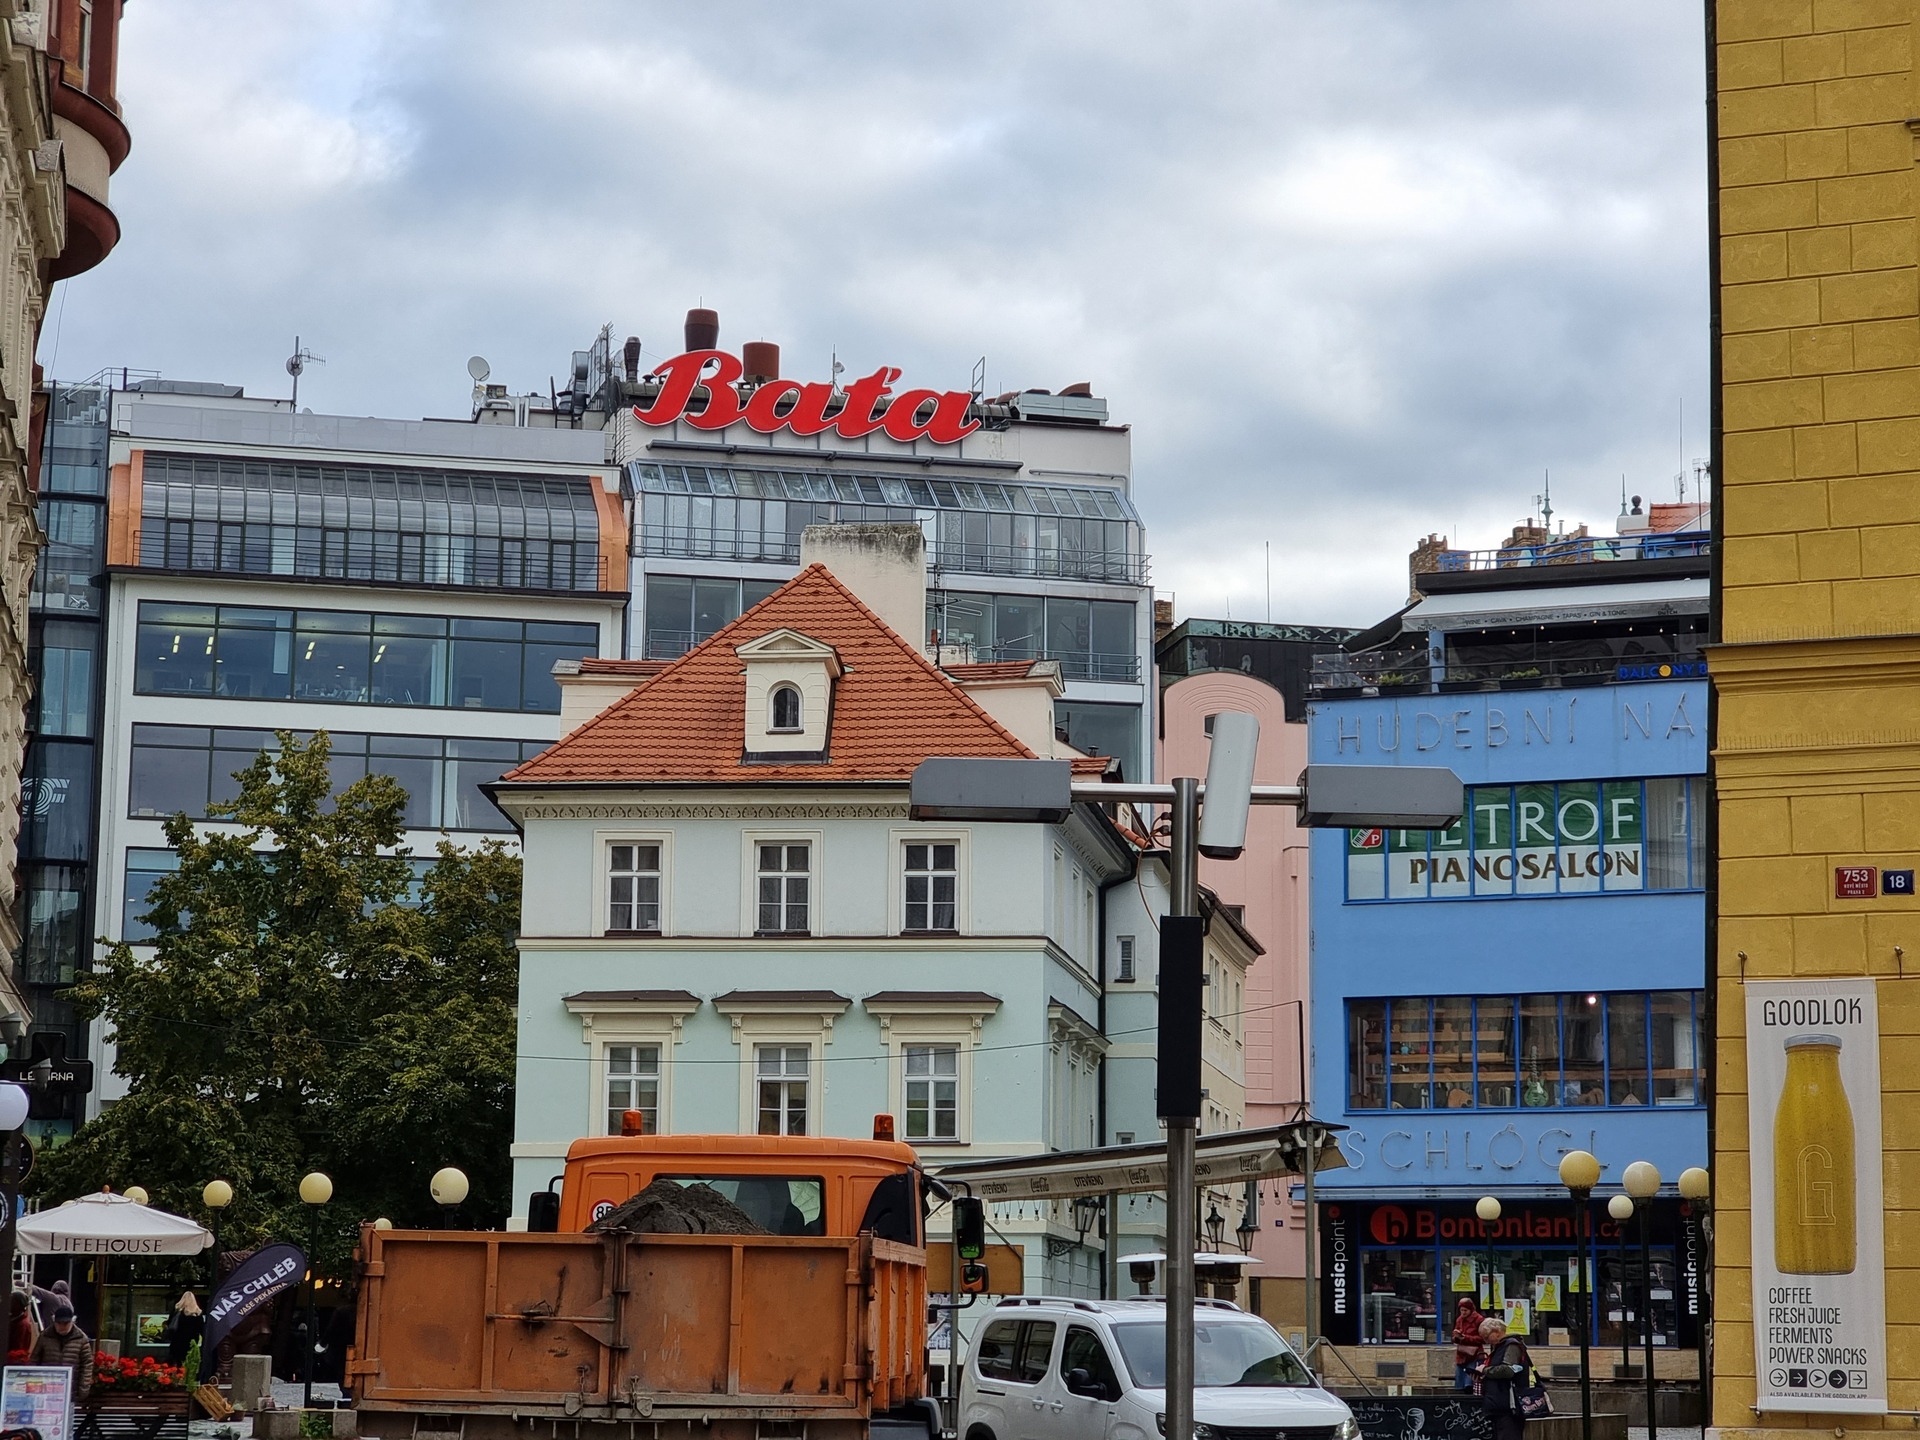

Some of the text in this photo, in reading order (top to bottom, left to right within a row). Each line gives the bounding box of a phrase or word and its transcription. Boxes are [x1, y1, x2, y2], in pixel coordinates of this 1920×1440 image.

[1338, 692, 1695, 755] HUDEBNÍ NÁ
[1398, 798, 1635, 848] ETROF
[1409, 849, 1640, 885] PIANOSALON
[1844, 870, 1868, 882] 753
[1889, 875, 1905, 889] 18
[1763, 998, 1862, 1026] GOODLOK
[19, 1071, 74, 1081] LÉRNA
[1797, 1144, 1837, 1226] G
[1330, 1220, 1349, 1314] musicpoint
[210, 1257, 297, 1321] NÁŠ CHLÉB
[1769, 1287, 1813, 1304] COFFEE
[1769, 1307, 1842, 1325] FRESH JUICE
[1769, 1327, 1833, 1344] FERMENTS
[1769, 1347, 1867, 1365] POWER SNACKS
